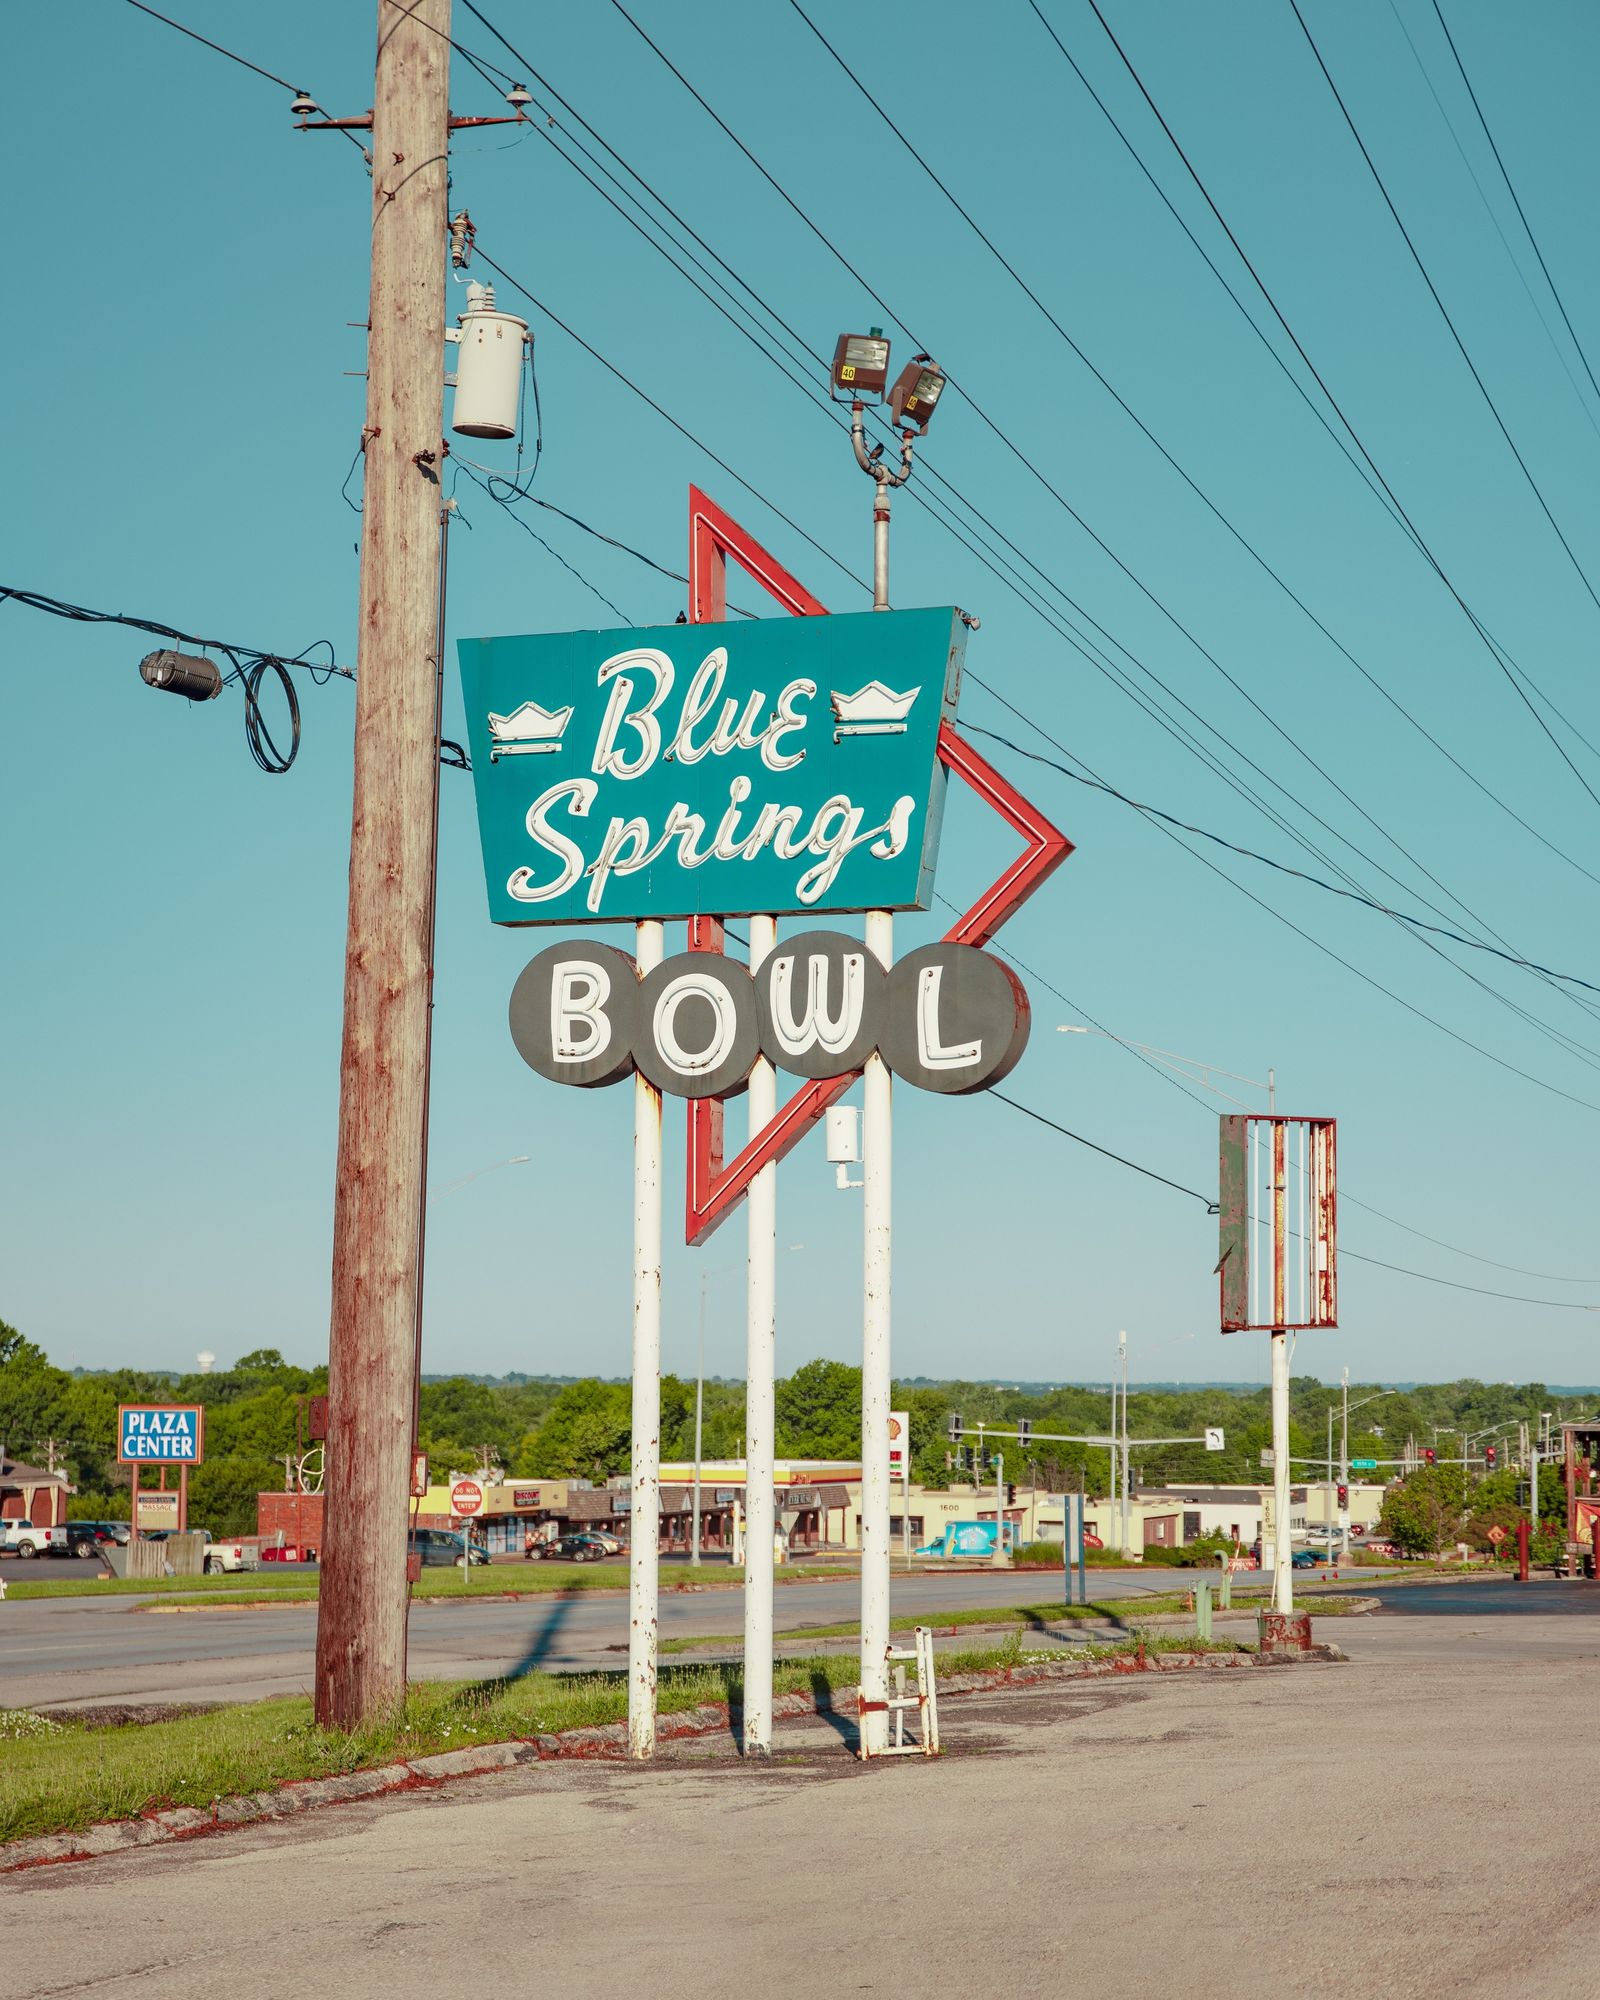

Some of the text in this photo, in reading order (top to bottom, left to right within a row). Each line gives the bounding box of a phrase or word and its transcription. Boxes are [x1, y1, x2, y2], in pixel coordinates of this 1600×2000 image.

[843, 368, 854, 378] 40
[592, 647, 816, 780] Blue
[507, 776, 915, 912] Springs
[551, 953, 982, 1076] BOWL
[128, 1413, 189, 1434] PLAZA
[124, 1435, 193, 1457] CENTER
[457, 1502, 476, 1510] ENTER
[516, 1491, 540, 1500] DISCOUNT
